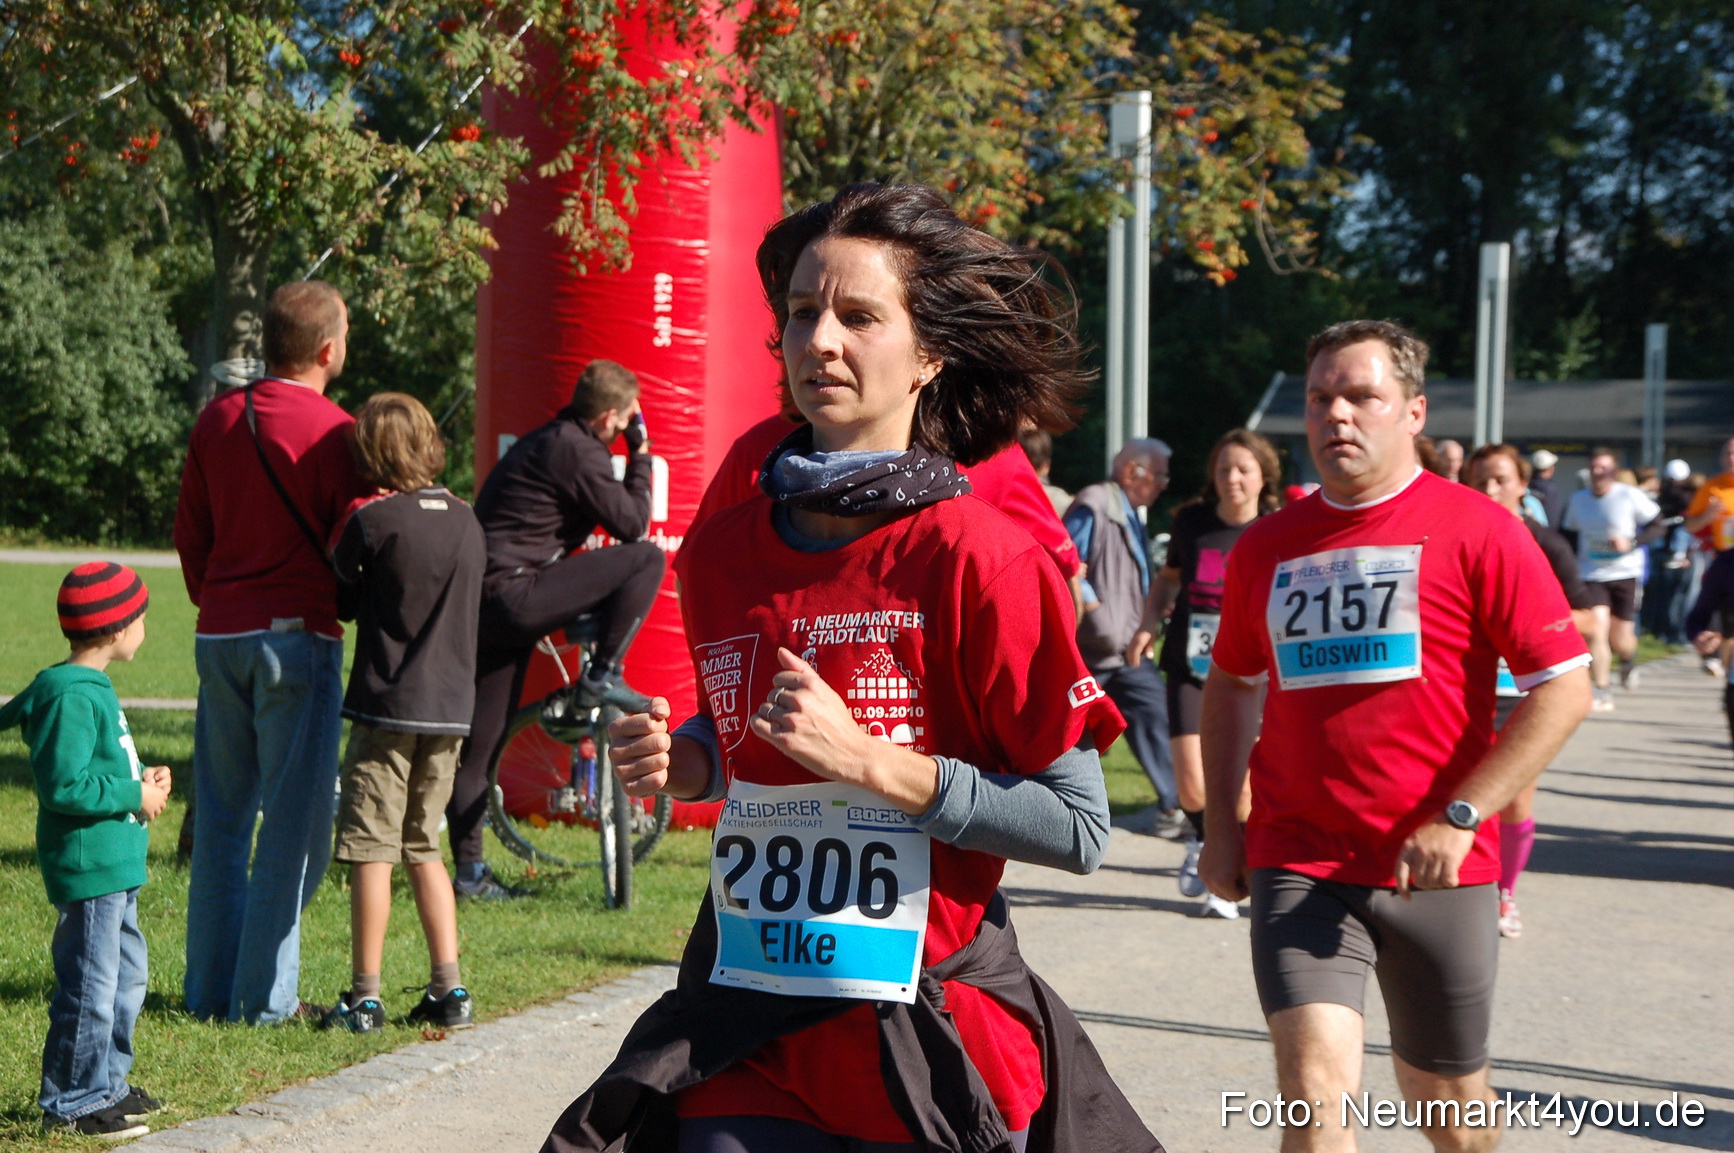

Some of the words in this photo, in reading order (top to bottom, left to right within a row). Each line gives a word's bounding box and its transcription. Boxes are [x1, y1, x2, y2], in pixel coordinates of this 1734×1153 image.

[792, 618, 811, 632] 11.
[813, 610, 925, 629] NEUMARKTER
[1284, 580, 1398, 637] 2157
[807, 627, 899, 646] STADTLAUF
[1299, 637, 1388, 668] Goswin
[722, 818, 823, 829] AKTIENGESELLSCHAFT
[724, 798, 822, 818] PFLEIDERER
[848, 806, 907, 823] BOCK
[716, 834, 899, 920] 2806
[760, 922, 836, 965] Elke
